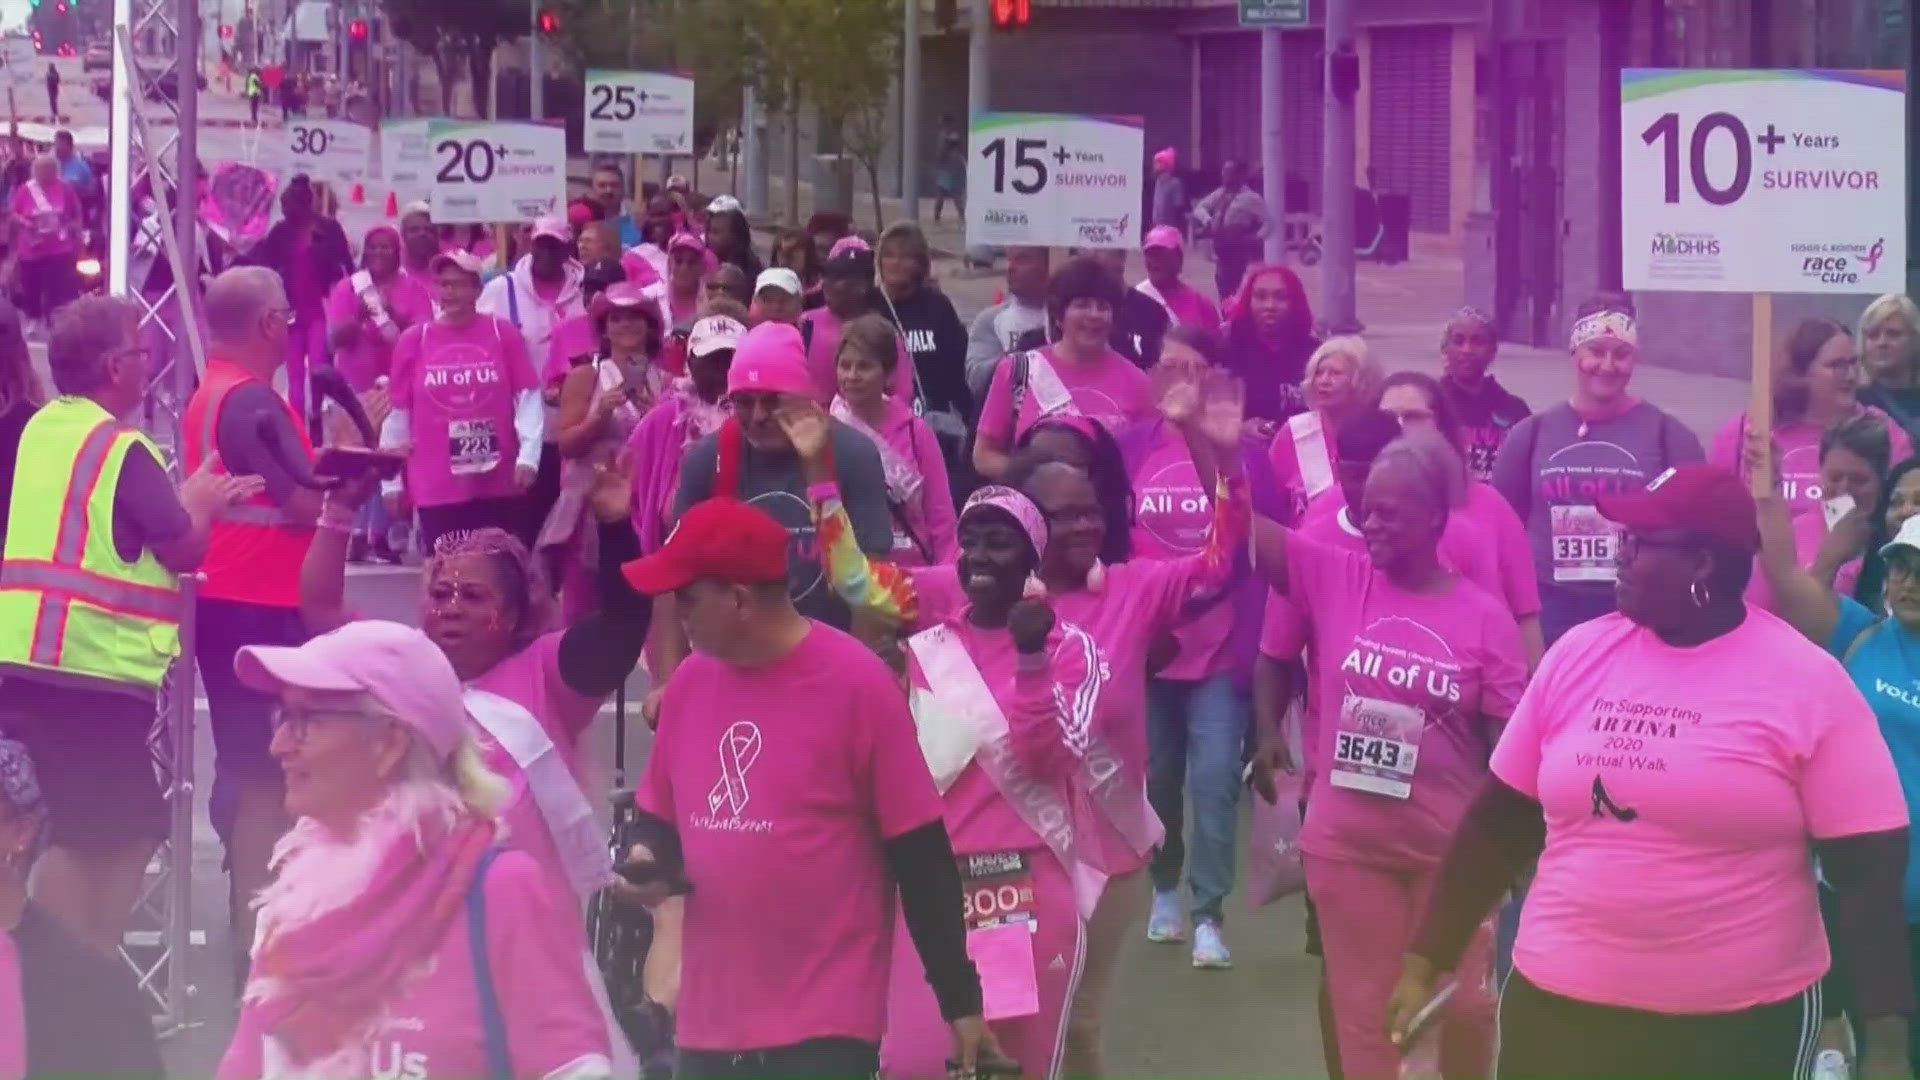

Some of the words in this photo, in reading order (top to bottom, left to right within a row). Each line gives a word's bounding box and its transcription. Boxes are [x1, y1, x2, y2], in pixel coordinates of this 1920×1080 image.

[1792, 132, 1839, 148] Years
[1055, 174, 1127, 188] SURVIVOR
[1763, 171, 1879, 190] SURVIVOR
[1803, 257, 1847, 271] race
[424, 370, 447, 386] All
[453, 370, 471, 385] of
[477, 368, 499, 383] Us
[1139, 495, 1172, 515] All
[1181, 494, 1209, 514] of
[1558, 538, 1608, 558] 3316
[1341, 649, 1383, 679] All
[1387, 665, 1420, 689] of
[1427, 670, 1461, 701] Us
[1616, 699, 1702, 725] Supporting
[1590, 716, 1677, 738] ARTINA
[1337, 735, 1400, 767] 3643
[1604, 737, 1643, 752] 2020
[1576, 753, 1624, 768] Virtual
[1629, 756, 1667, 772] Walk
[370, 1040, 428, 1080] Us
